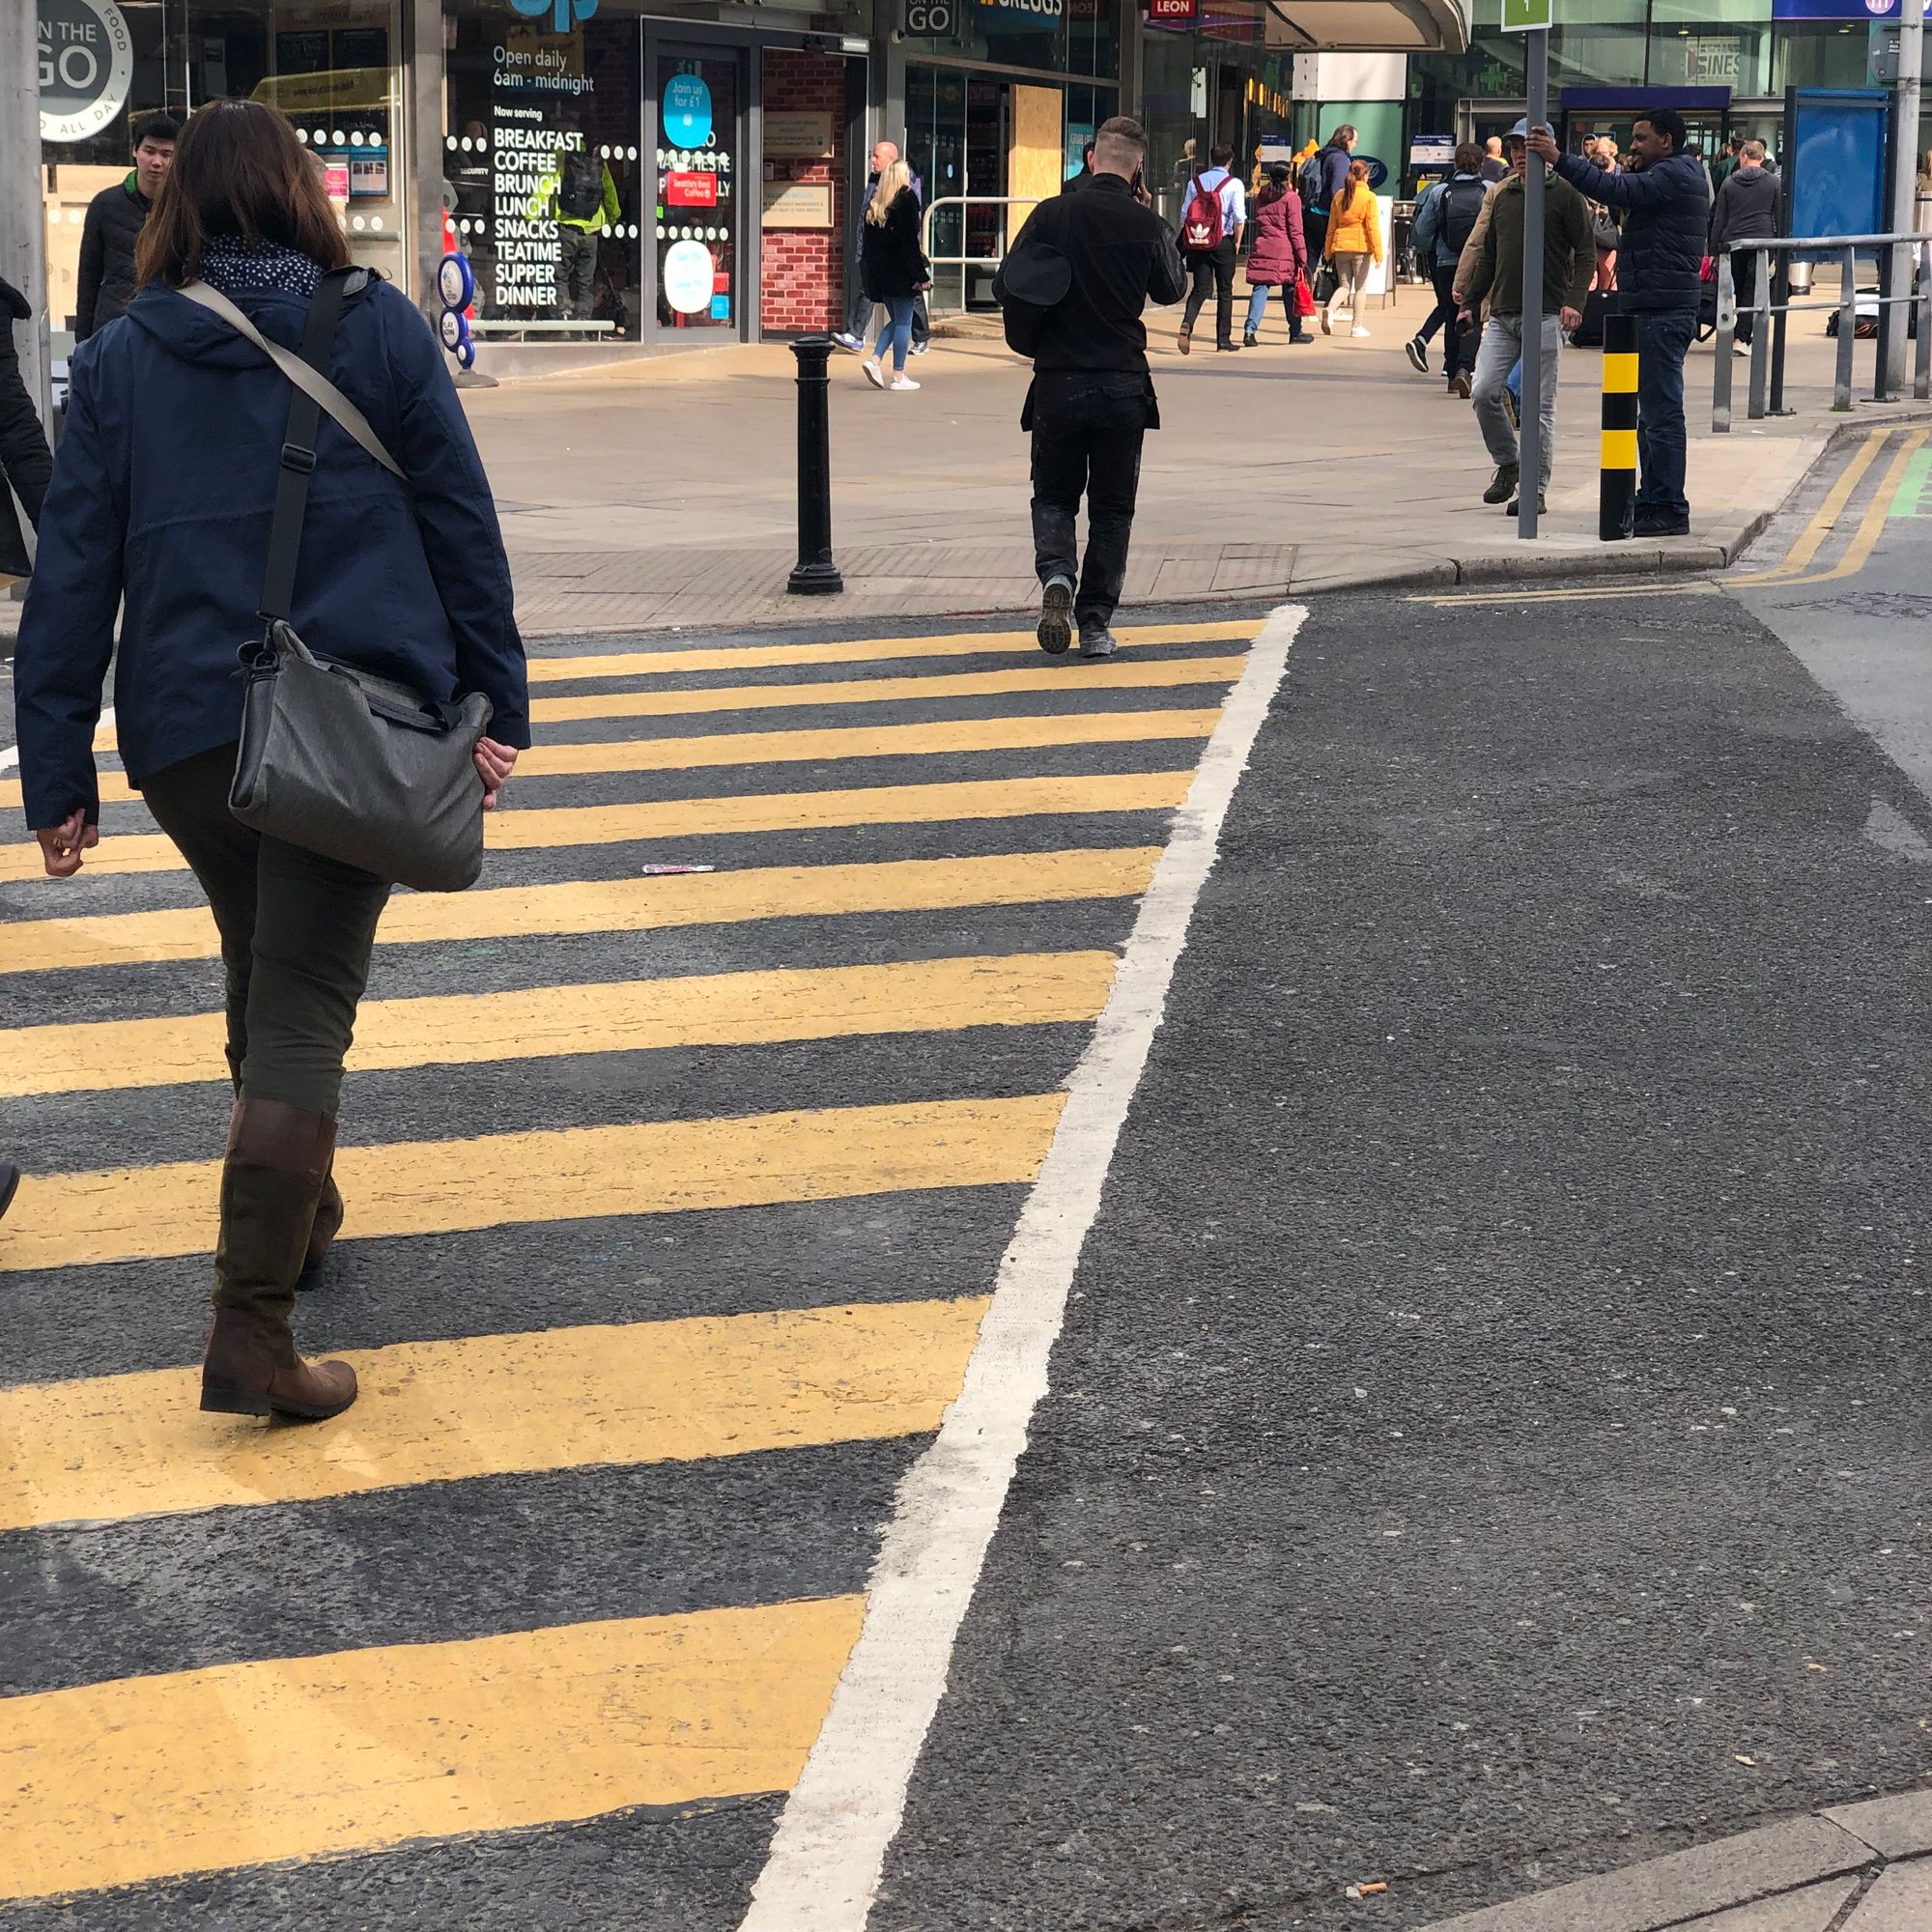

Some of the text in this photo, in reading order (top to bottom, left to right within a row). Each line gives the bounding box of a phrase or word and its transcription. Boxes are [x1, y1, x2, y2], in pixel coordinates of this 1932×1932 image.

[1157, 0, 1189, 12] LEON
[909, 6, 950, 31] GO
[39, 21, 97, 43] N THE
[103, 8, 127, 51] FOOD
[494, 45, 567, 72] Open daily
[494, 69, 524, 87] 6am
[535, 71, 594, 96] midnight
[672, 82, 702, 95] Join us
[674, 97, 699, 107] for £1
[60, 122, 86, 134] ALL
[94, 94, 117, 121] DAY
[494, 105, 543, 123] Now serving
[494, 128, 583, 152] BREAKFAST
[460, 167, 489, 176] SECURITY
[494, 151, 556, 173] COFFEE
[495, 173, 561, 195] BRUNCH
[673, 179, 697, 188] Seattle's
[697, 180, 711, 188] Best
[684, 188, 704, 198] Coffee
[495, 196, 549, 216] LUNCH
[495, 218, 558, 240] SNACKS
[495, 241, 562, 262] TEATIME
[495, 263, 555, 283] SUPPER
[496, 286, 557, 305] DINNER
